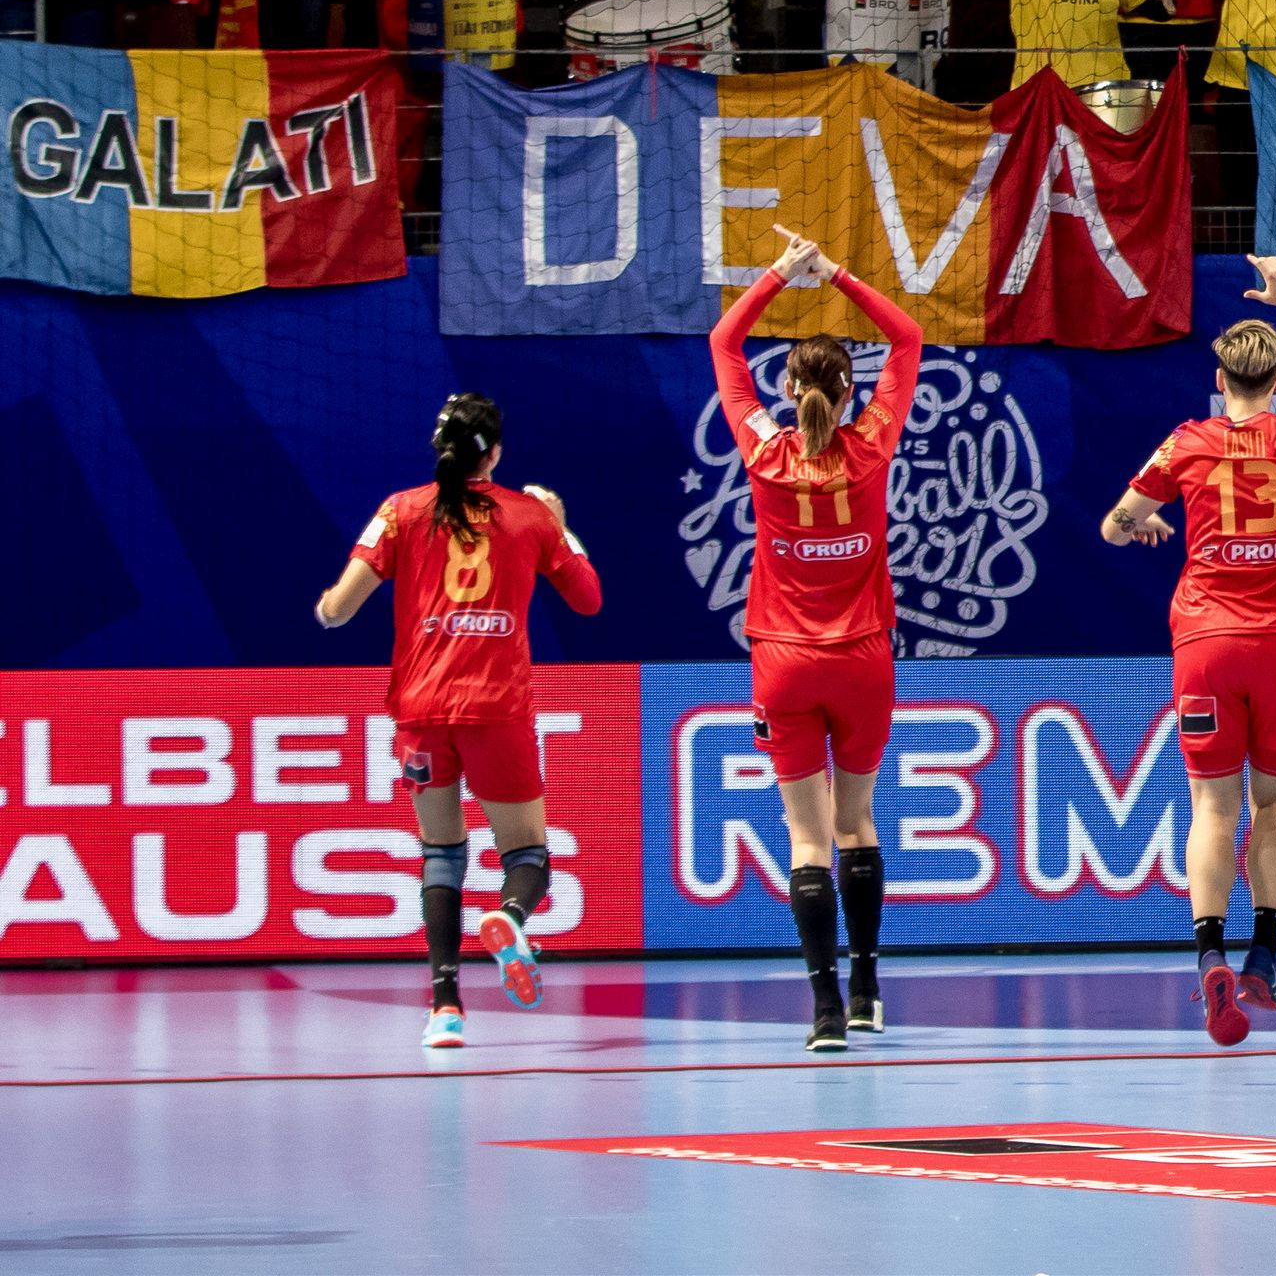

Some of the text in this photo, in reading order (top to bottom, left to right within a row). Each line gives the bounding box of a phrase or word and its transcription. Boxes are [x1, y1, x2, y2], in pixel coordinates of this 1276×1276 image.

[868, 0, 897, 12] BRD
[523, 114, 1149, 299] DEVA
[788, 480, 853, 528] 11
[802, 539, 865, 558] PROFI
[446, 535, 494, 603] 8
[452, 614, 508, 633] PROFI
